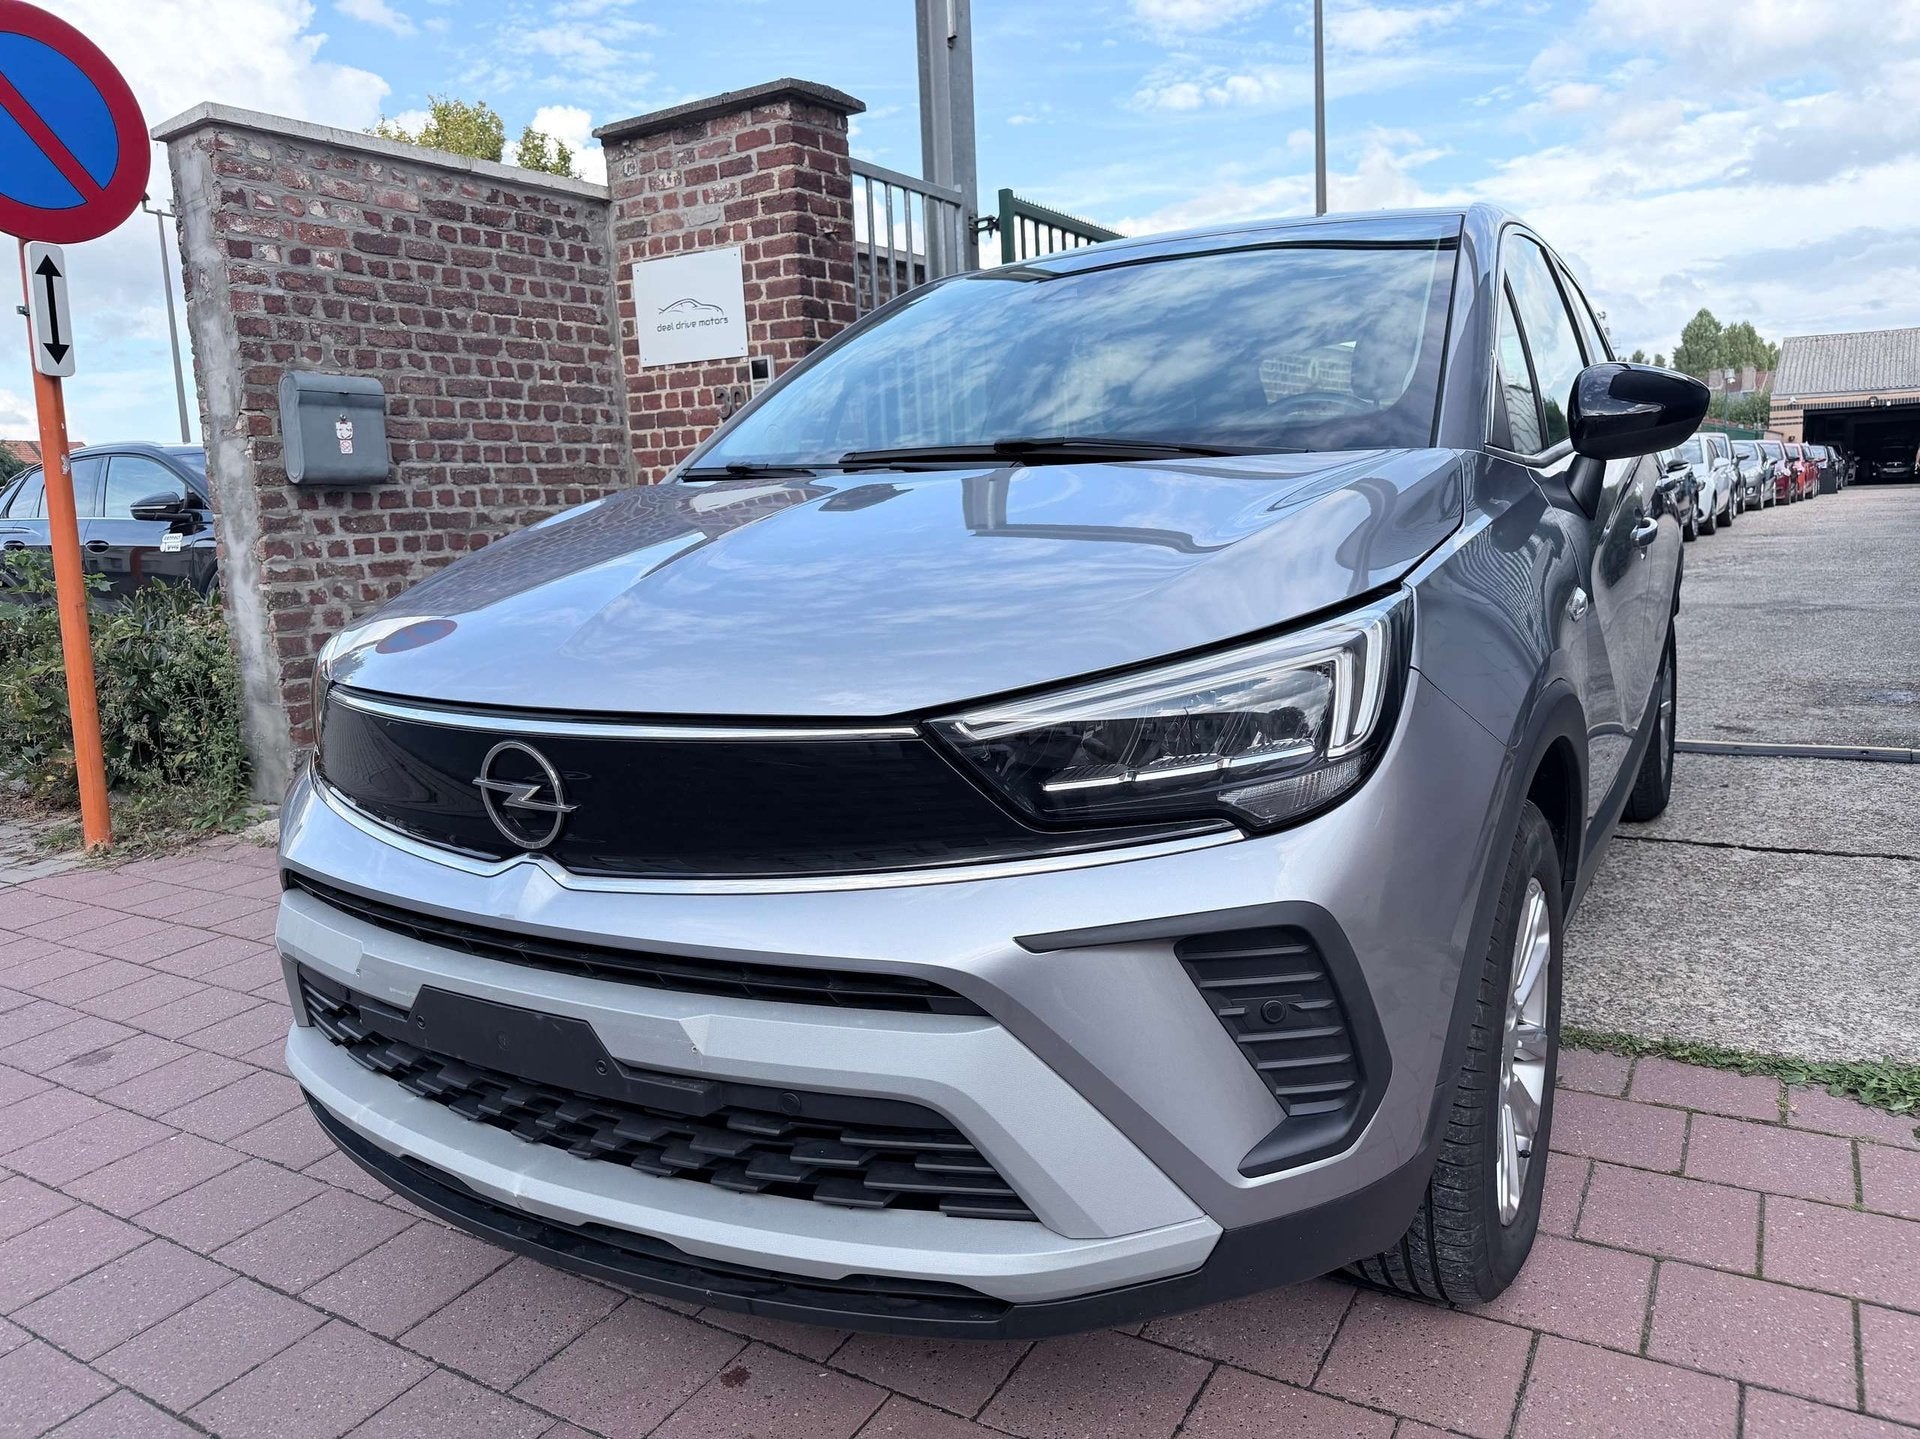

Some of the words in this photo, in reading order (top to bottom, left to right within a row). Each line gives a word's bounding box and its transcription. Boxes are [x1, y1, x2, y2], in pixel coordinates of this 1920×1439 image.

[656, 322, 674, 333] deal
[675, 320, 697, 330] drive
[698, 316, 729, 327] motors
[715, 385, 747, 420] 30
